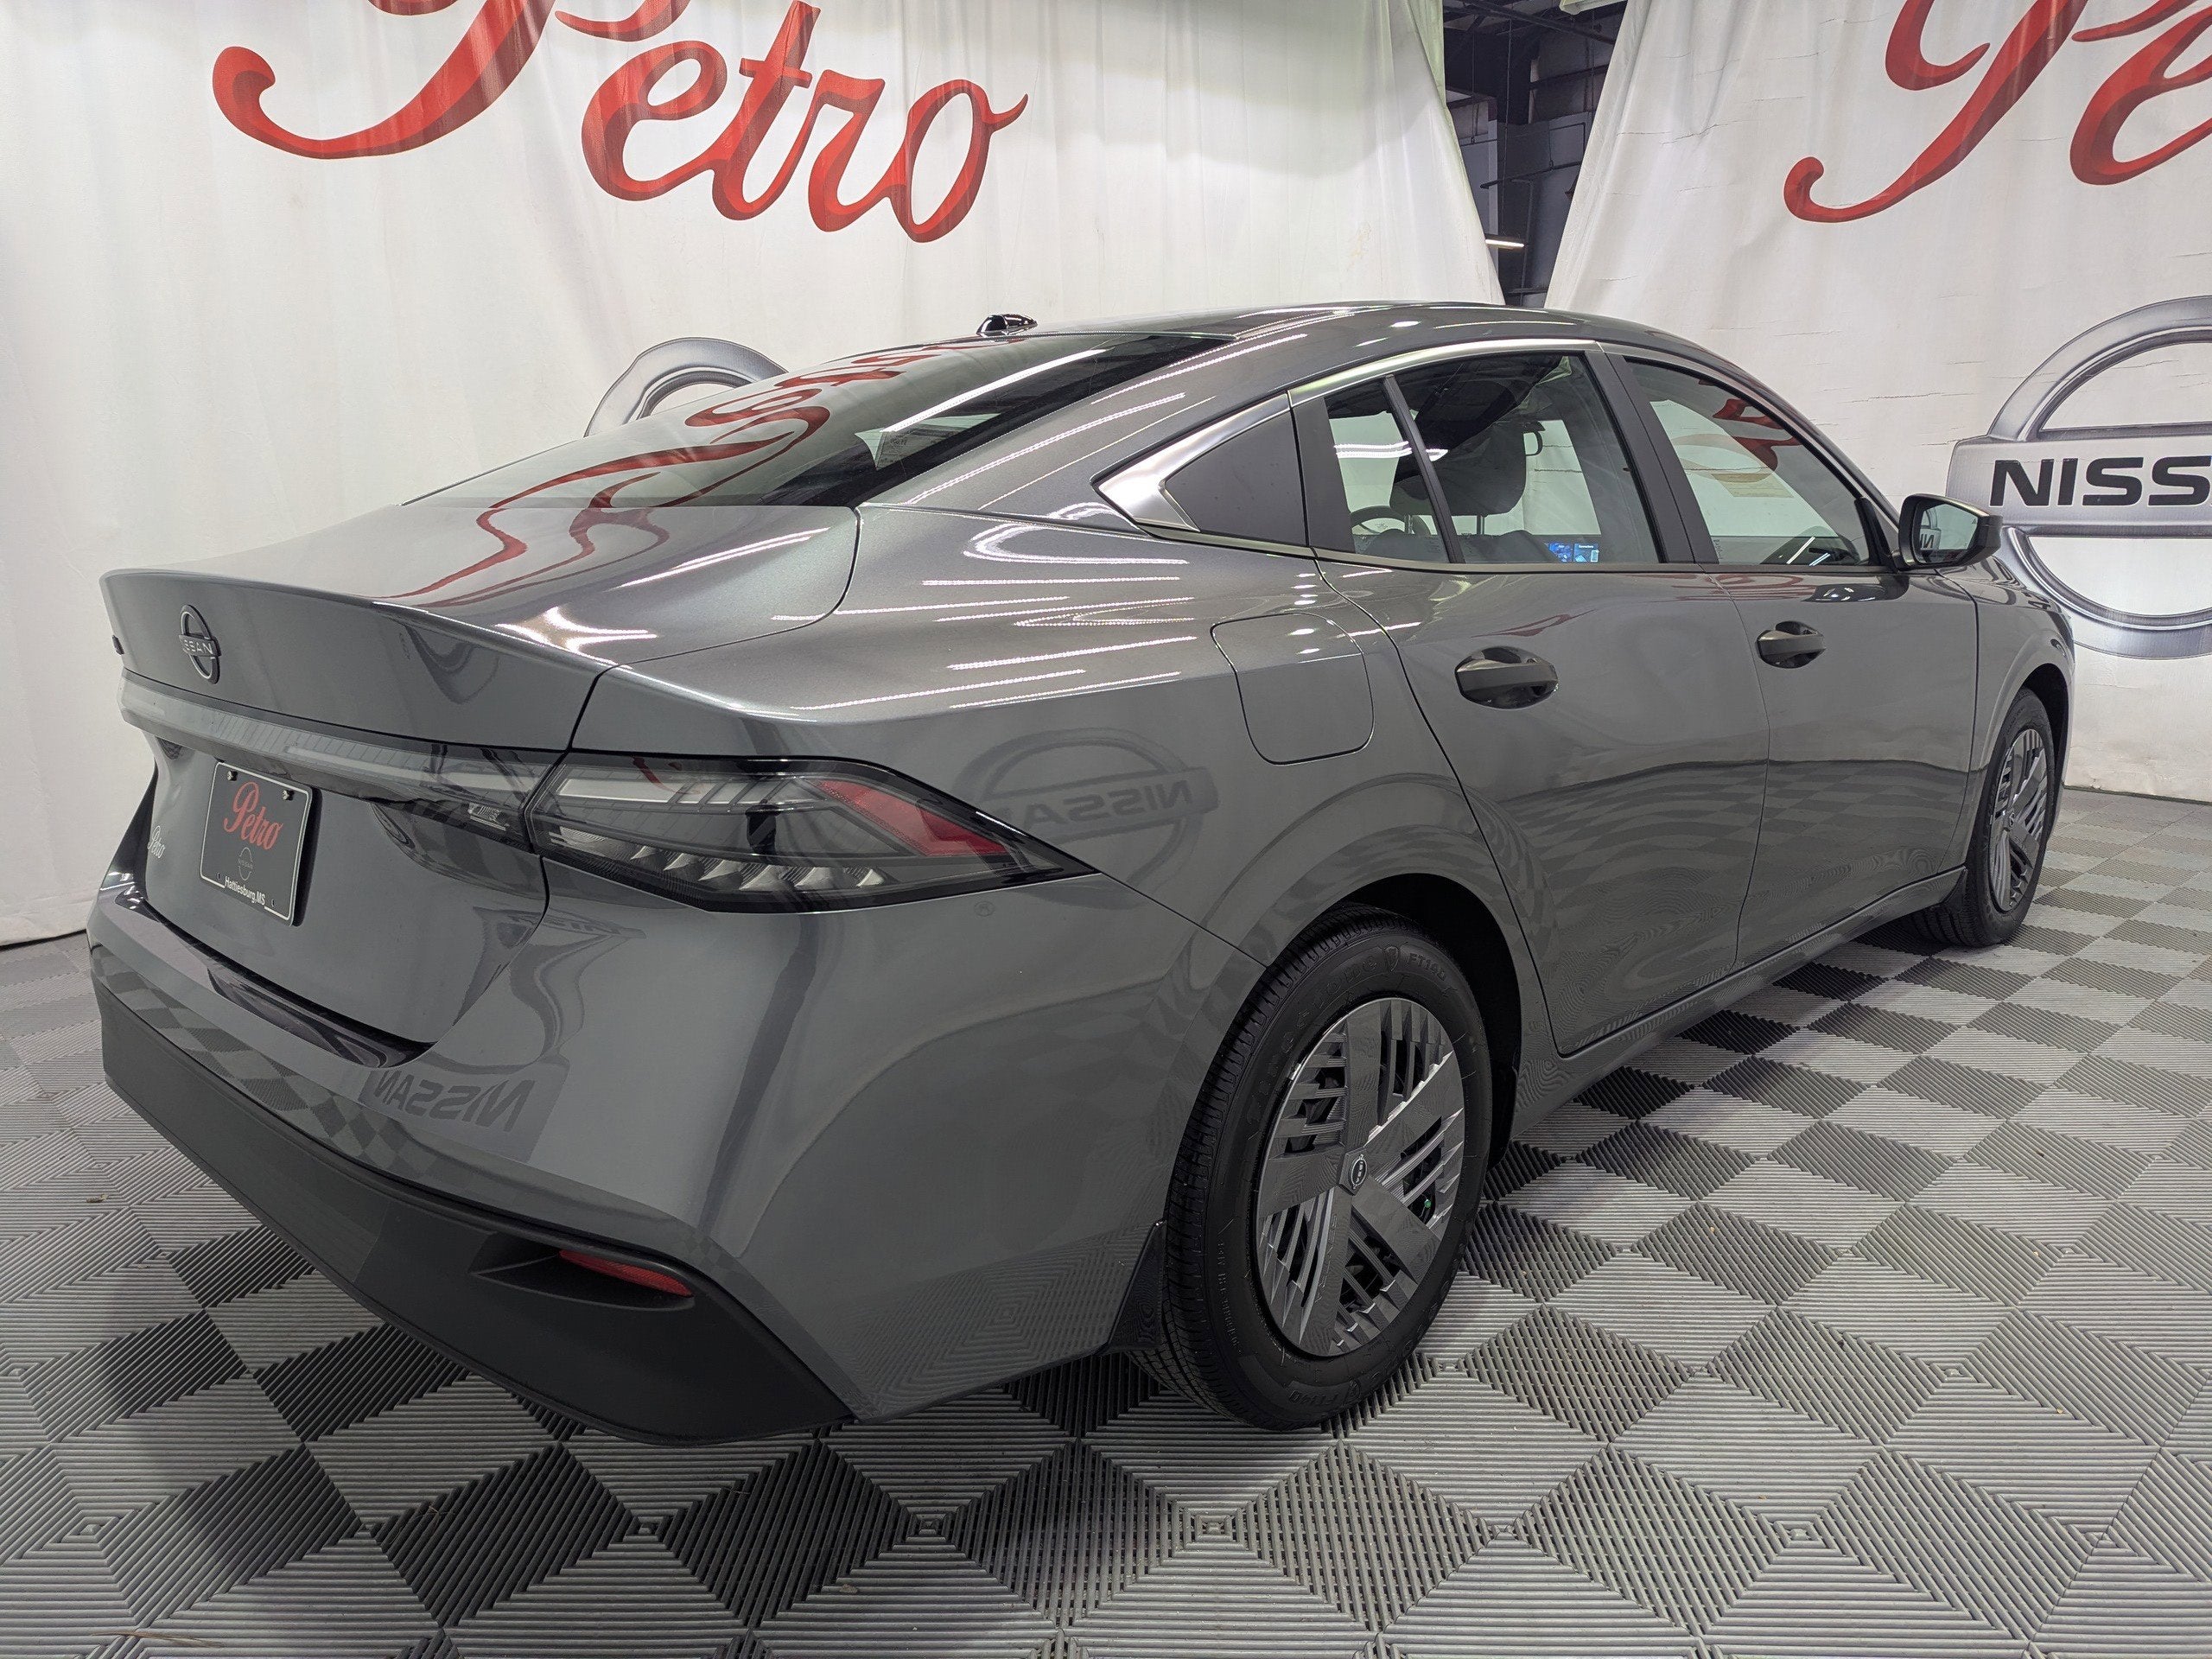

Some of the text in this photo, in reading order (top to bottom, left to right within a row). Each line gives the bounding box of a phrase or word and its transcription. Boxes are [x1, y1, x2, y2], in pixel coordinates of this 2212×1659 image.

[180, 639, 213, 655] SSAN
[223, 781, 283, 850] Petro
[147, 825, 166, 858] Petro
